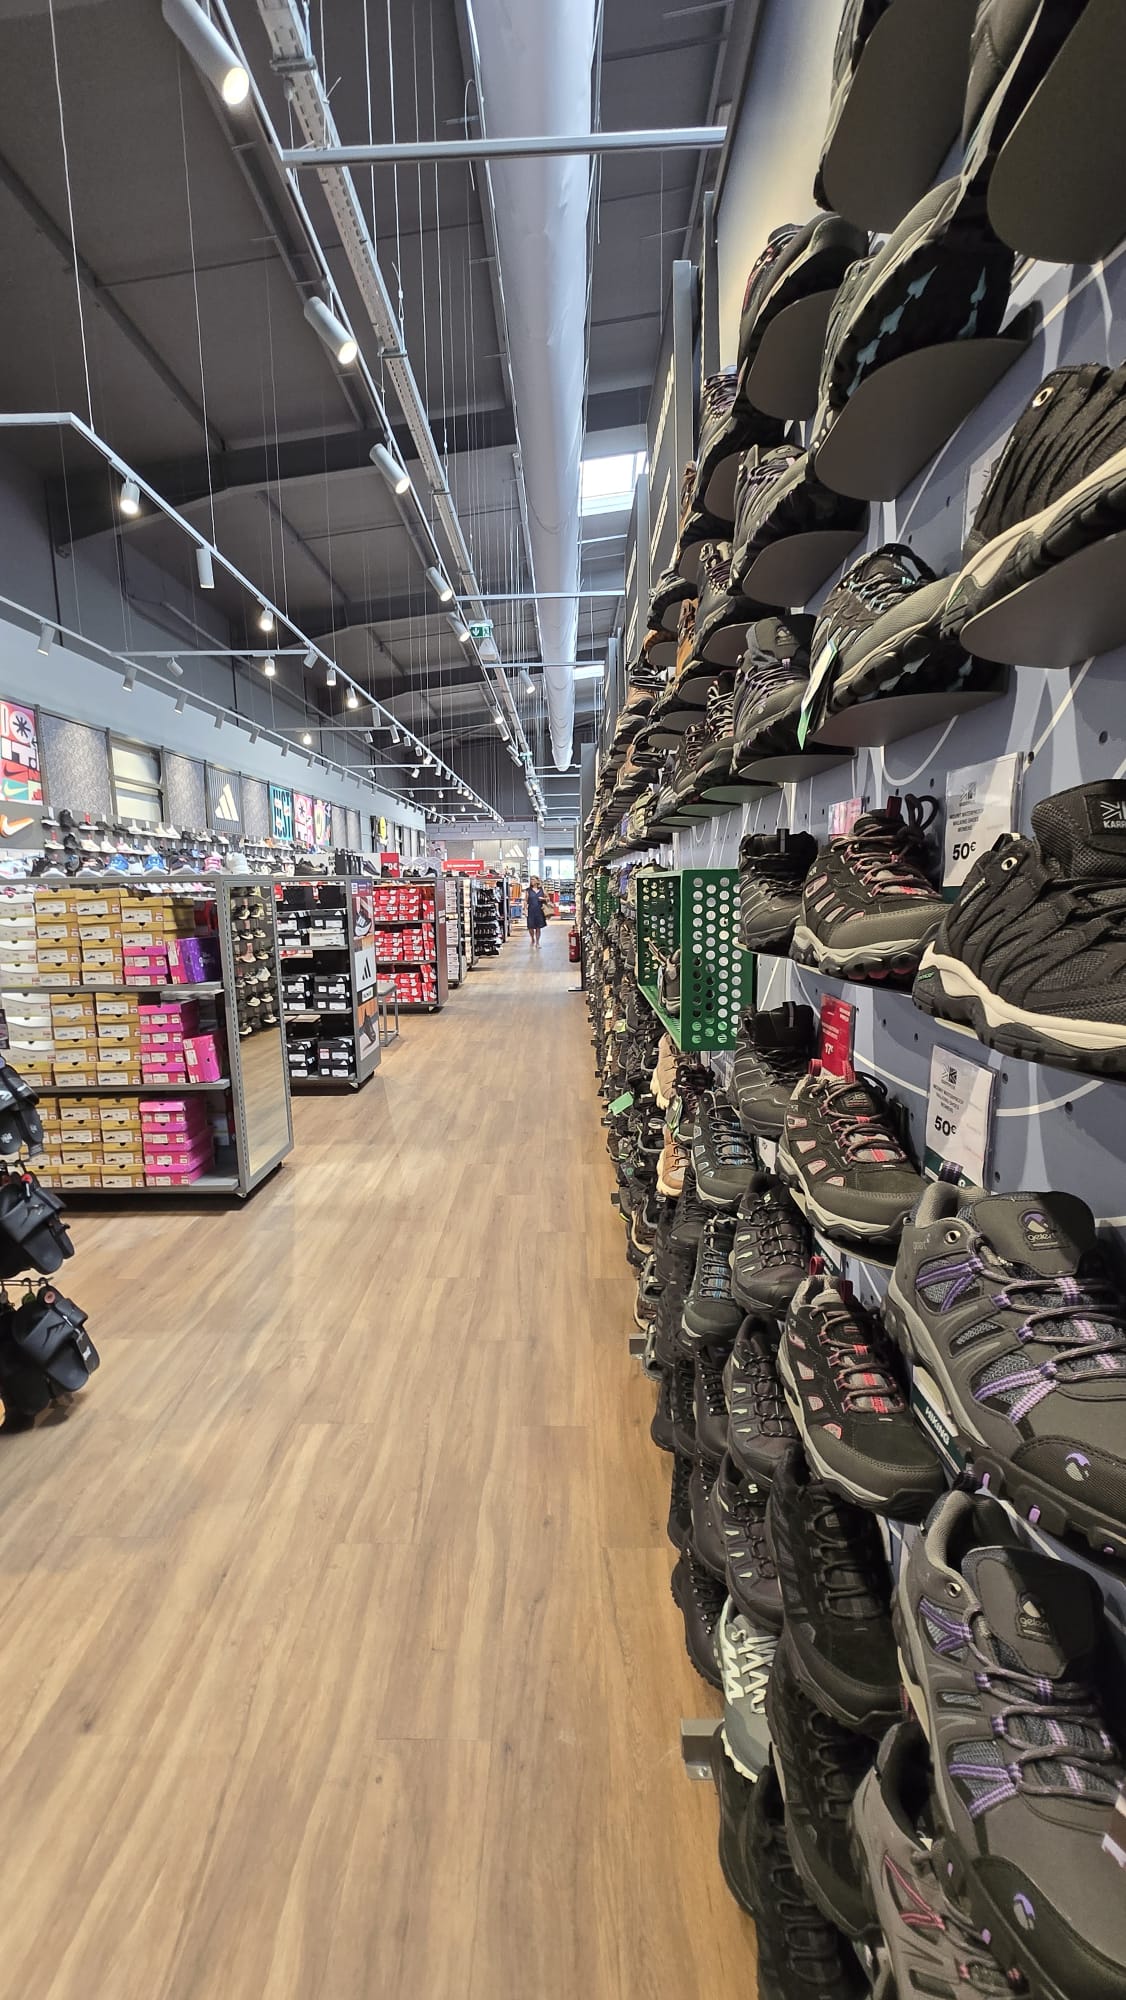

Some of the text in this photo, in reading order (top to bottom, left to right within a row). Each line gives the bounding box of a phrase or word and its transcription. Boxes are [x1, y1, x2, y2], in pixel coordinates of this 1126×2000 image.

[952, 841, 976, 860] 50€
[934, 1115, 957, 1136] 50€
[925, 1406, 950, 1446] HIKING
